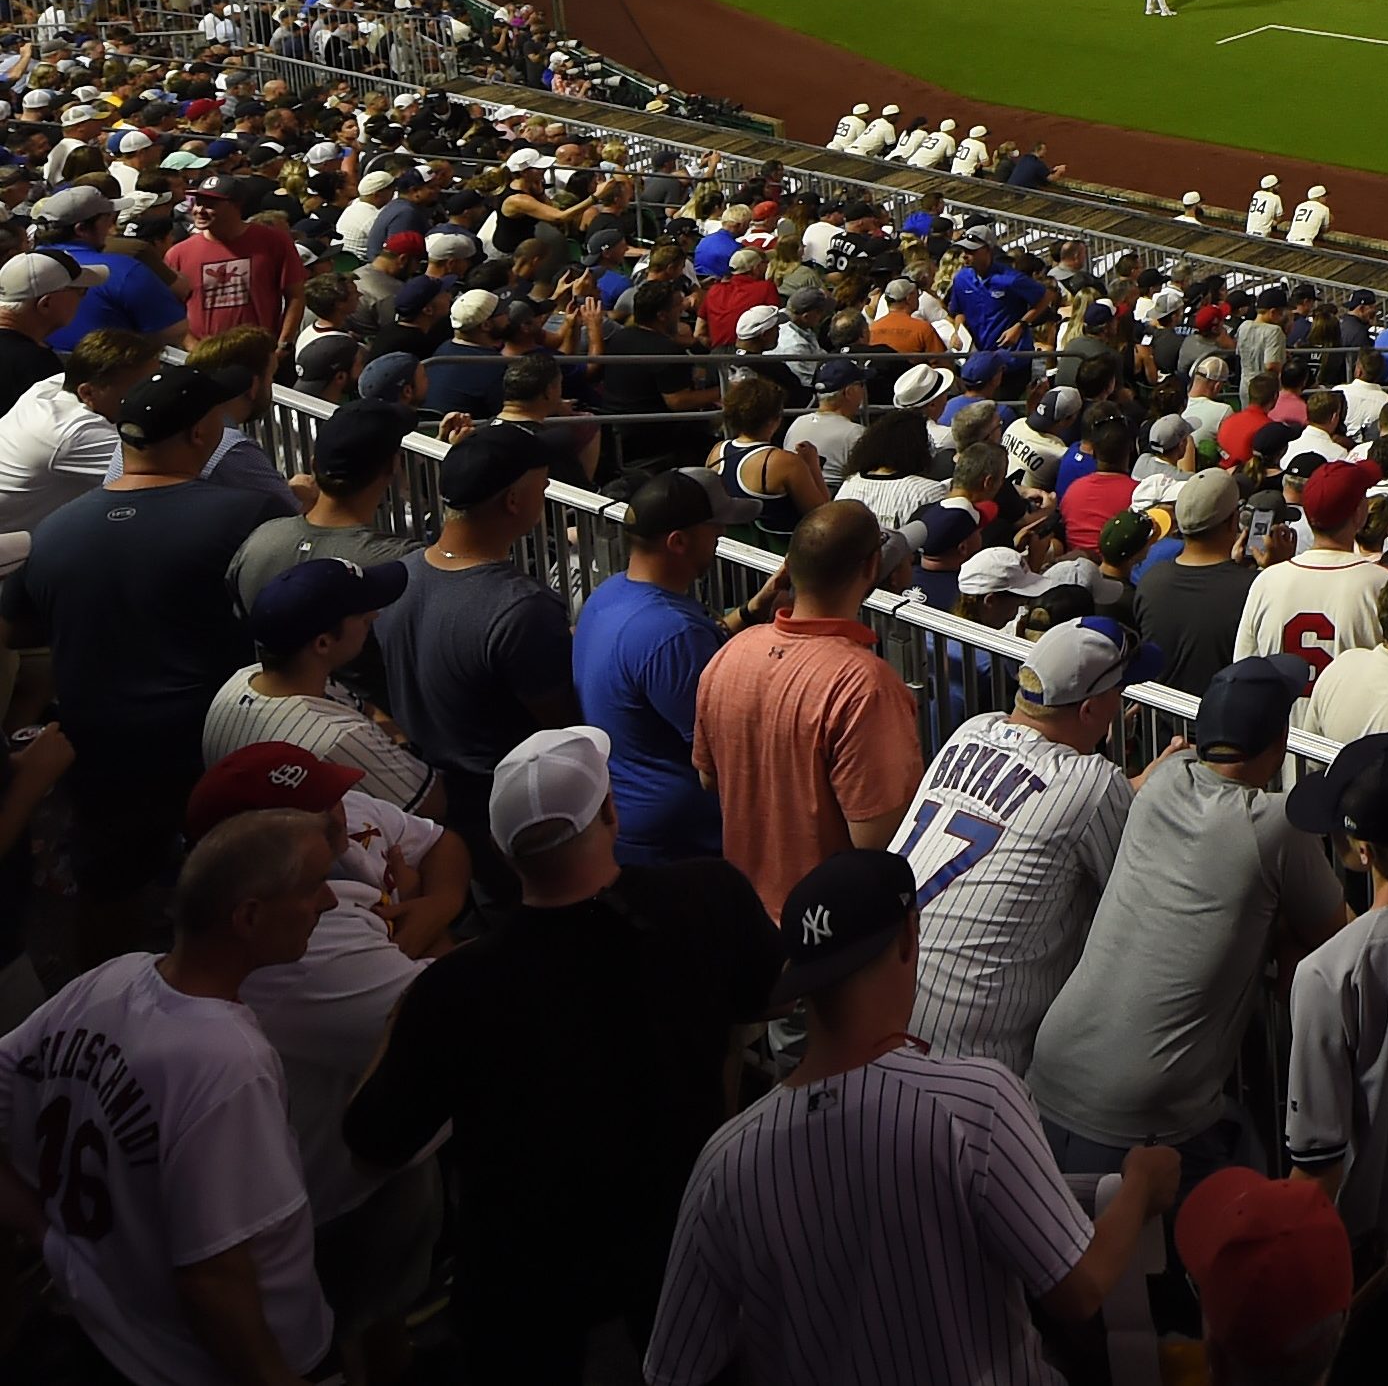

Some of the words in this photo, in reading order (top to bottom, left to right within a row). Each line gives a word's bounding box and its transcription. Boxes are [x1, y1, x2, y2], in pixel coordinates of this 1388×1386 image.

[1295, 208, 1313, 223] 21
[1001, 433, 1045, 472] ONERKO
[930, 743, 1046, 821] BRYANT
[900, 798, 1006, 910] 17
[801, 903, 833, 945] NY
